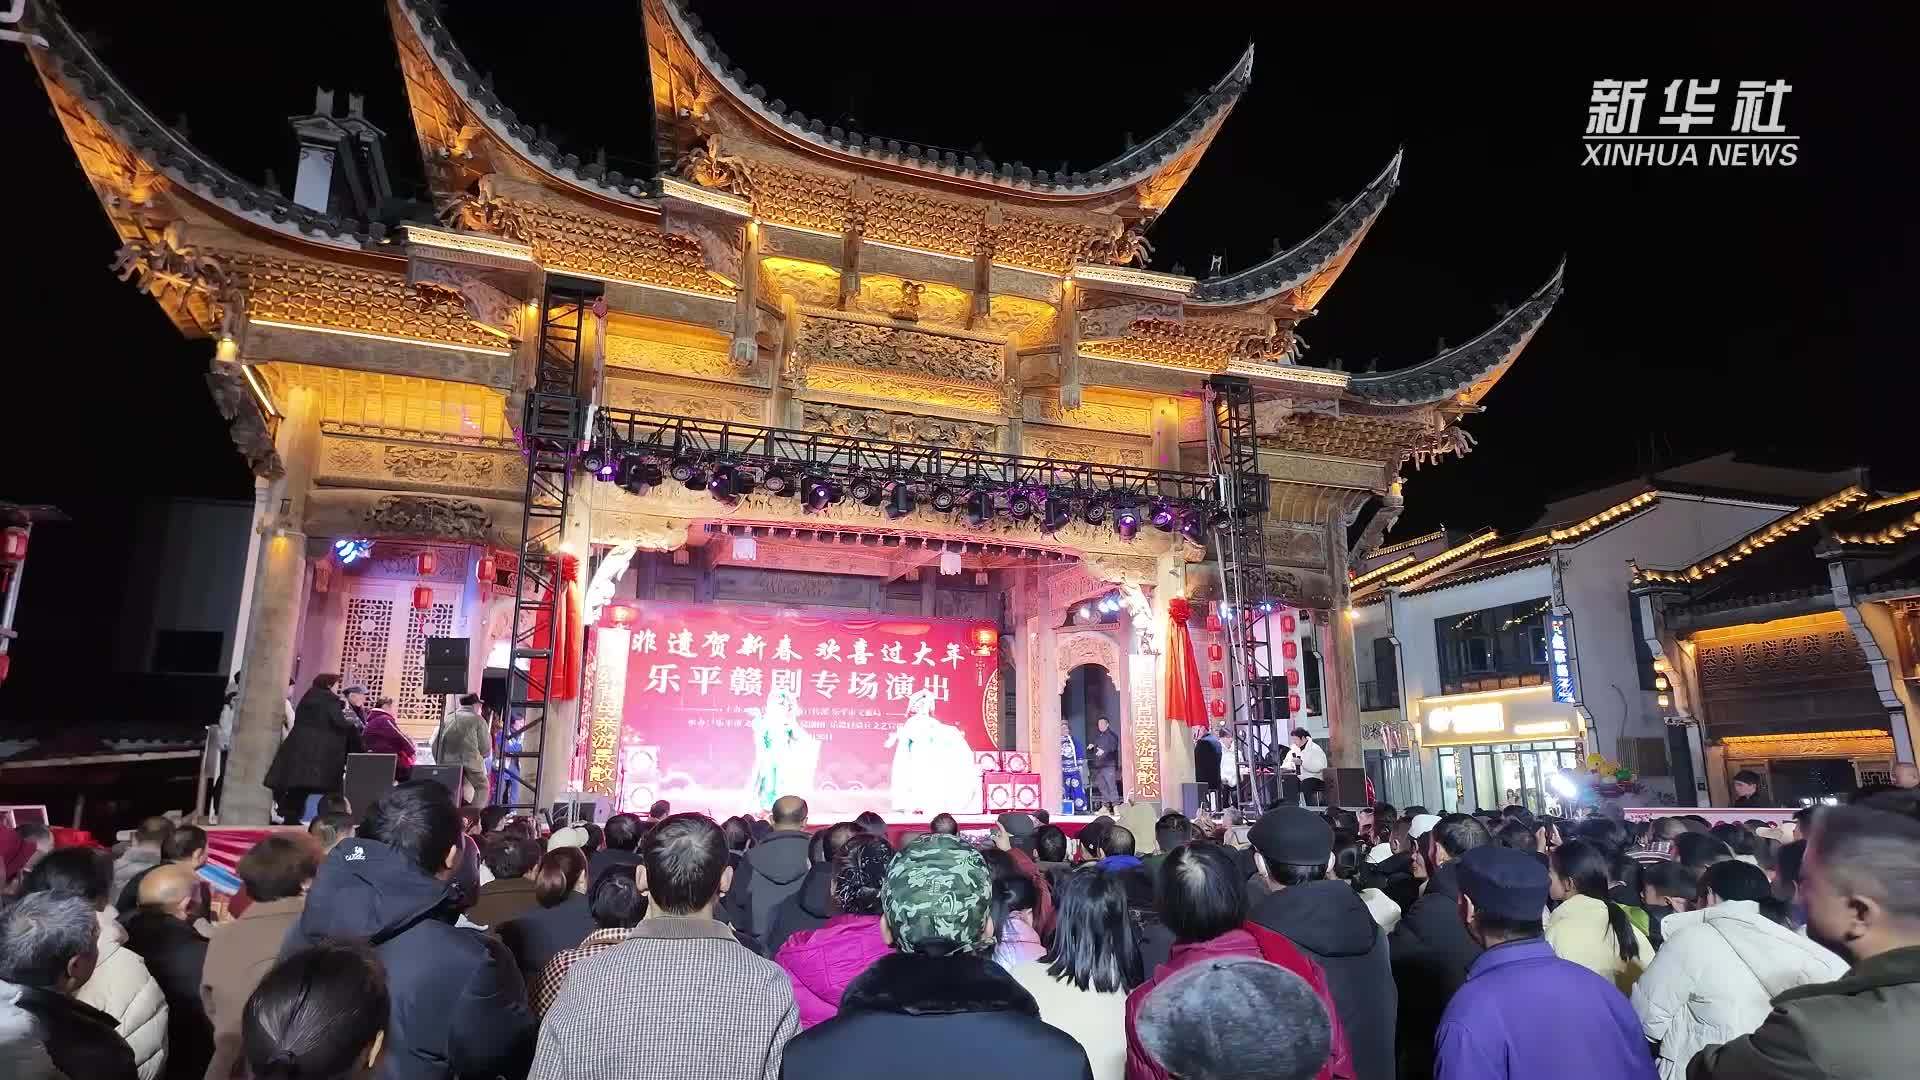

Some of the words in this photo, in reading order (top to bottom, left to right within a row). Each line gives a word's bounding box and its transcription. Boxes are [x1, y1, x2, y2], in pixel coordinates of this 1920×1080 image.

[631, 628, 803, 663] 非遗贺新春
[815, 637, 965, 671] 欢喜过大年
[644, 663, 950, 702] 乐平赣剧专场演出
